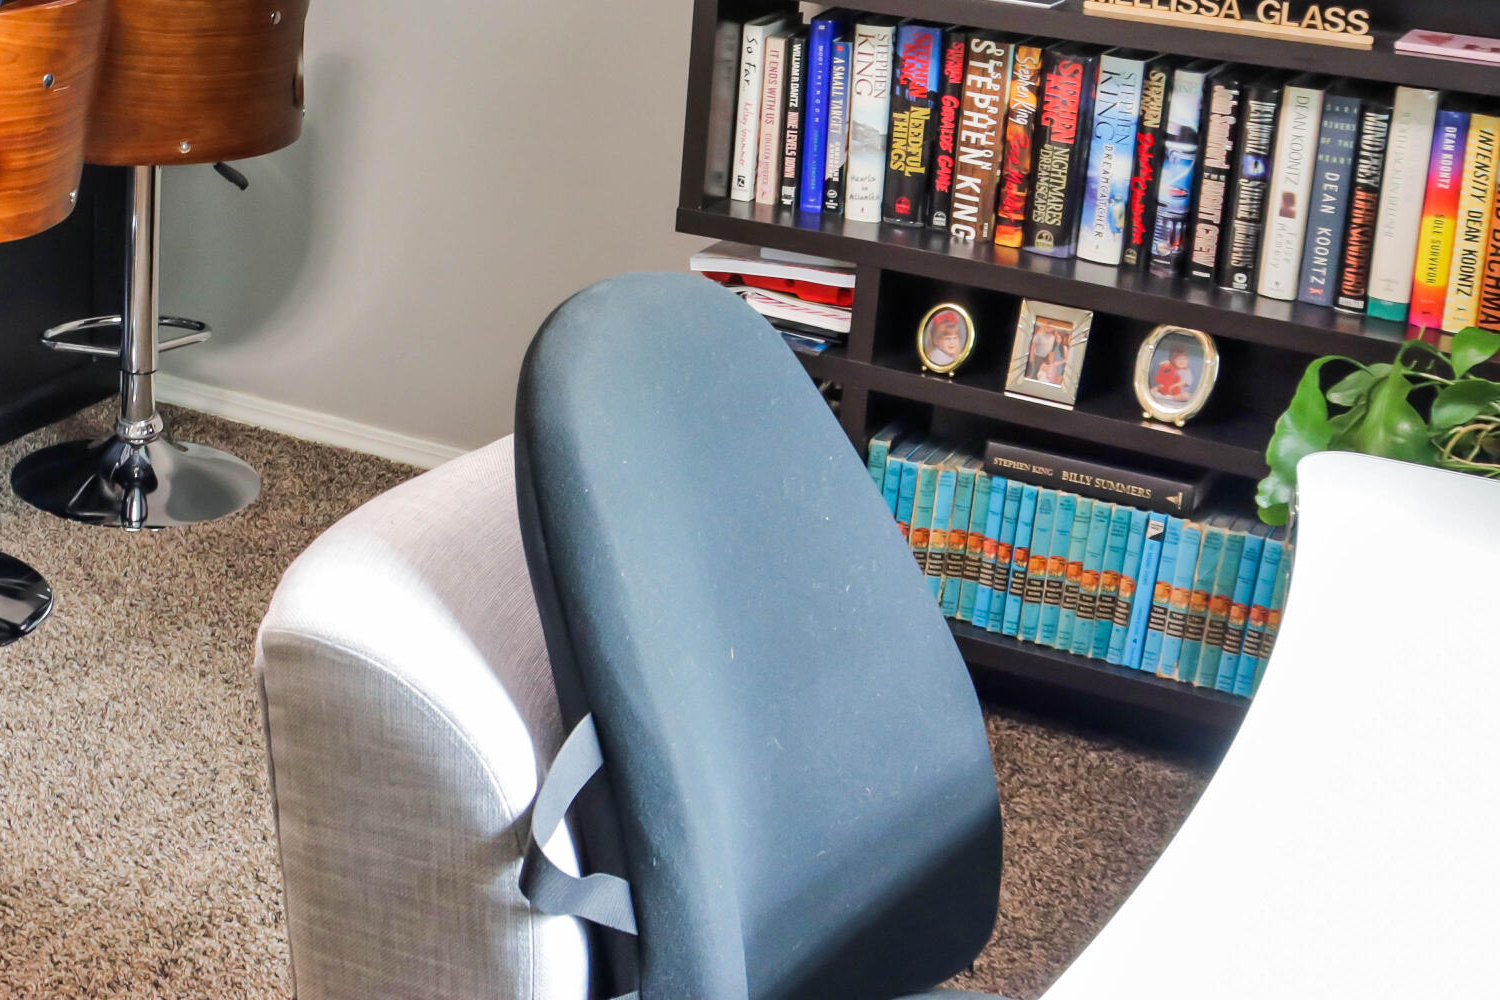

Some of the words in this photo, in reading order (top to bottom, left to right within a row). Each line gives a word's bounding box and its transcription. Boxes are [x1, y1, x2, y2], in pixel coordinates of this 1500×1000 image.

[1257, 0, 1370, 35] GLASS
[768, 61, 779, 88] ENDS
[770, 50, 780, 61] IT
[791, 43, 801, 77] WILLIAM
[854, 32, 876, 97] KING
[873, 32, 889, 100] STEPHEN
[899, 42, 914, 86] KING
[908, 31, 934, 99] STEPHEN
[767, 88, 777, 112] WITH
[789, 83, 799, 108] DANTZ
[832, 65, 844, 96] SMALL
[959, 37, 993, 166] STEPHEN
[1041, 72, 1058, 127] KING
[1050, 59, 1084, 145] STEPHEN
[1143, 70, 1166, 129] STEPHEN
[1211, 84, 1239, 115] John
[766, 112, 775, 125] US
[787, 111, 799, 129] NINE
[829, 99, 843, 135] TARGET
[981, 48, 1005, 171] DESPERATION
[1094, 69, 1121, 141] KING
[1115, 71, 1136, 146] STEPHEN
[1293, 95, 1310, 135] DEAN
[785, 129, 798, 157] LEVELS
[889, 111, 910, 172] THINGS
[904, 105, 931, 178] NEEDFUL
[1204, 114, 1237, 170] Sandford
[1284, 134, 1304, 187] KOONTZ
[1445, 126, 1458, 152] DEAN
[784, 157, 796, 179] DOWN
[1045, 146, 1070, 227] NIGHTMARES
[1437, 153, 1453, 190] KOONTZ
[1470, 129, 1495, 205] INTENSITY
[950, 173, 982, 242] KING
[1094, 144, 1114, 238] DREAMCATCHER
[1198, 179, 1226, 225] NIGHT
[1319, 171, 1341, 215] DEAN
[1192, 223, 1220, 268] CREW
[1433, 213, 1445, 236] SOLE
[1463, 209, 1484, 244] DEAN
[1310, 226, 1333, 291] KOONTZ
[1426, 238, 1441, 284] SURVIVOR
[1456, 248, 1478, 298] KOONTZ
[993, 456, 1031, 474] STEPHEN
[1032, 463, 1054, 477] KING
[1061, 469, 1093, 488] BILLY
[1094, 476, 1152, 500] SUMMERS
